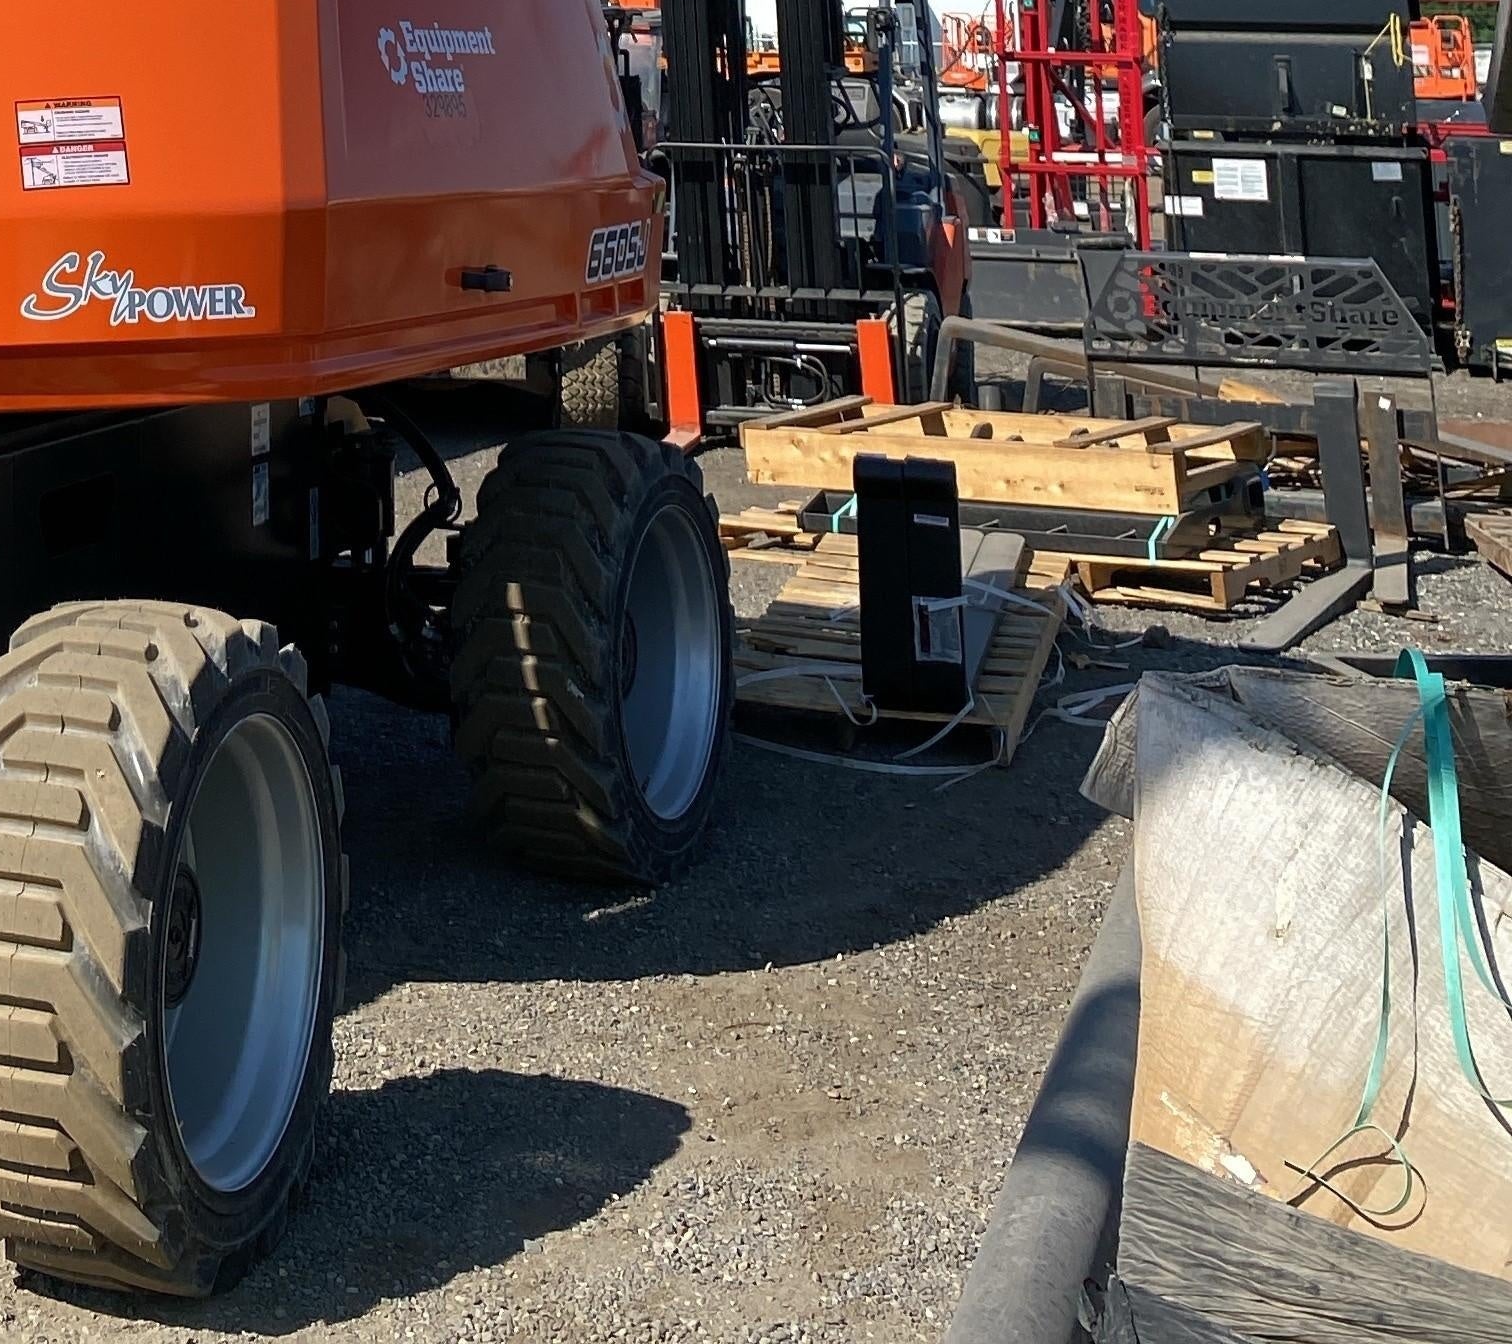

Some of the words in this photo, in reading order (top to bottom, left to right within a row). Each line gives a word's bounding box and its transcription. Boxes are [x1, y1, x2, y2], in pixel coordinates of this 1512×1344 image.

[399, 21, 495, 61] Equipment
[410, 60, 465, 94] Share
[53, 100, 92, 109] WARNING
[59, 144, 94, 153] DANGER
